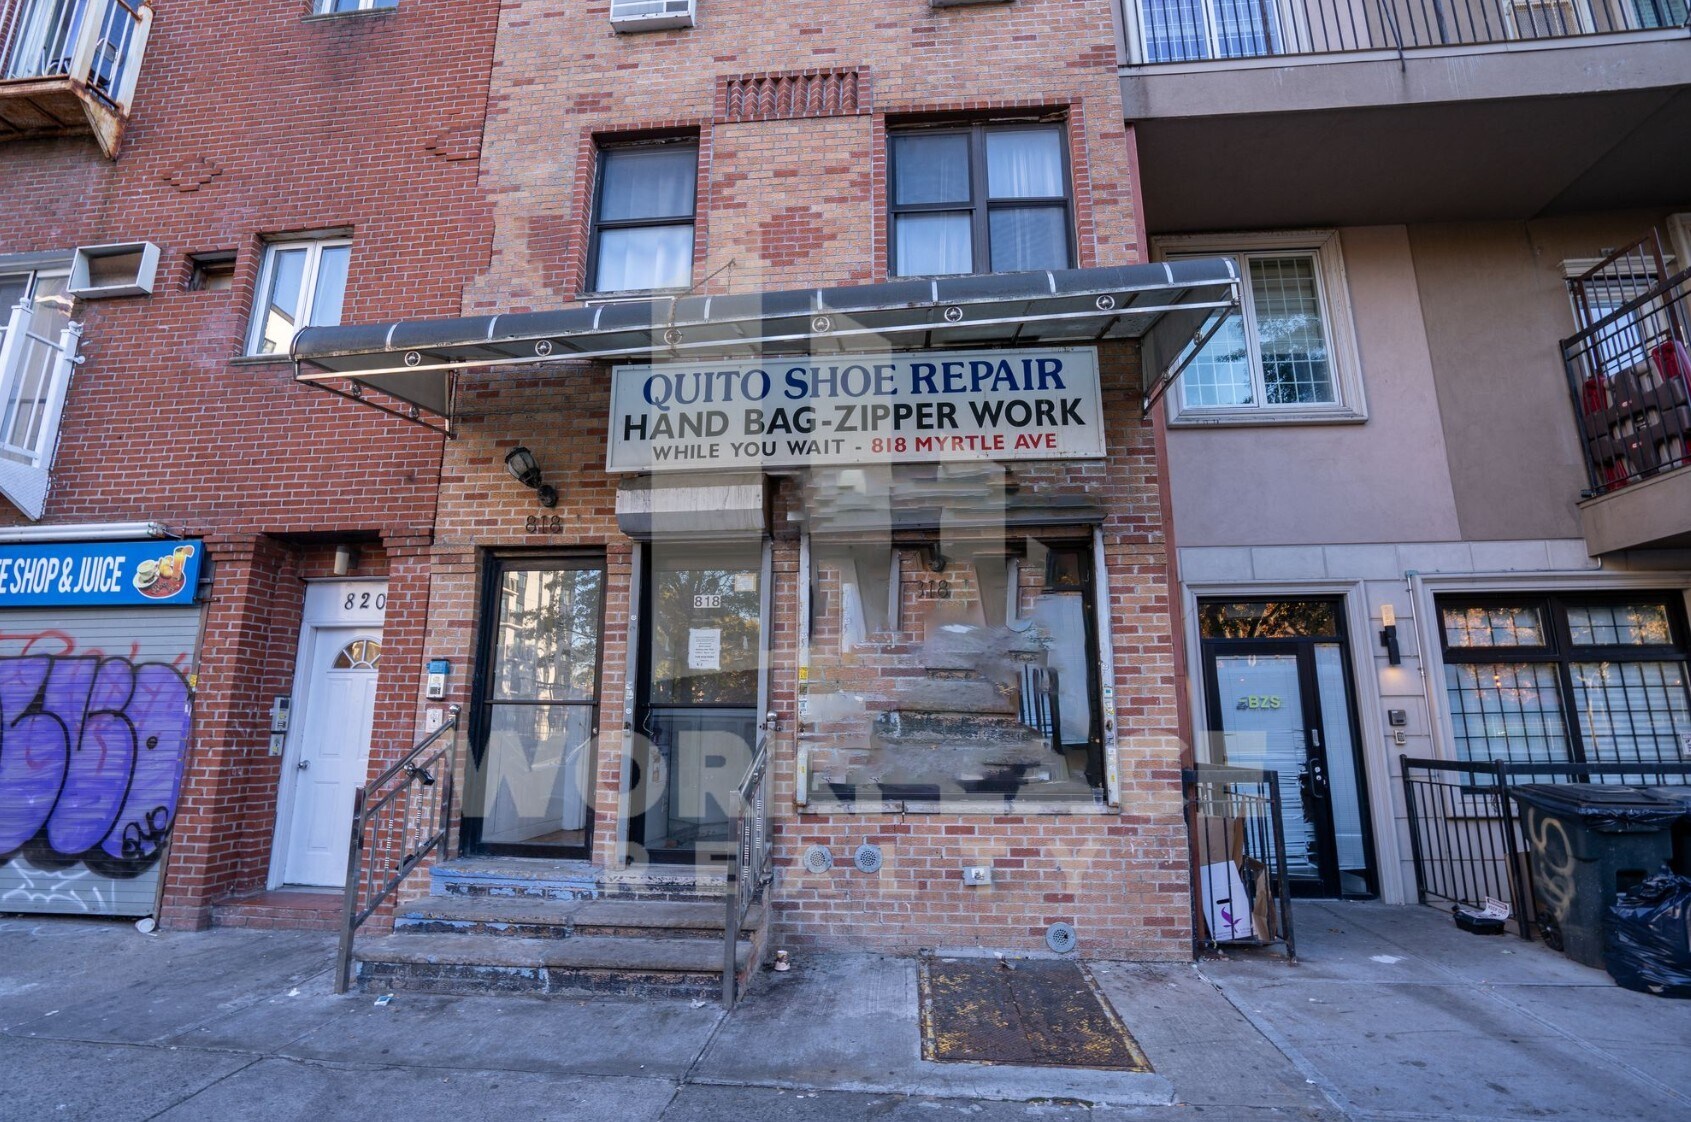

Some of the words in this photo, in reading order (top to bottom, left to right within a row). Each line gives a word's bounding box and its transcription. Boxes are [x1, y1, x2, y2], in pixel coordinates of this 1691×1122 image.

[643, 368, 771, 411] QUITO
[784, 363, 897, 400] SHOE
[911, 357, 1067, 395] REPAIR
[623, 410, 730, 441] HAND
[743, 401, 958, 436] BAG-ZIPPER
[968, 397, 1086, 428] WORK
[652, 442, 720, 460] WHILE
[730, 440, 777, 458] YOU
[787, 438, 846, 456] WAIT
[871, 436, 907, 453] 818
[914, 433, 1006, 452] MYRTLE
[1014, 432, 1058, 450] AVE
[525, 515, 563, 534] 818
[9, 557, 60, 594] SHOP
[58, 556, 73, 593] &
[73, 555, 126, 593] JUICE
[344, 592, 386, 611] 820
[693, 594, 721, 608] 818
[1248, 694, 1281, 709] BZS
